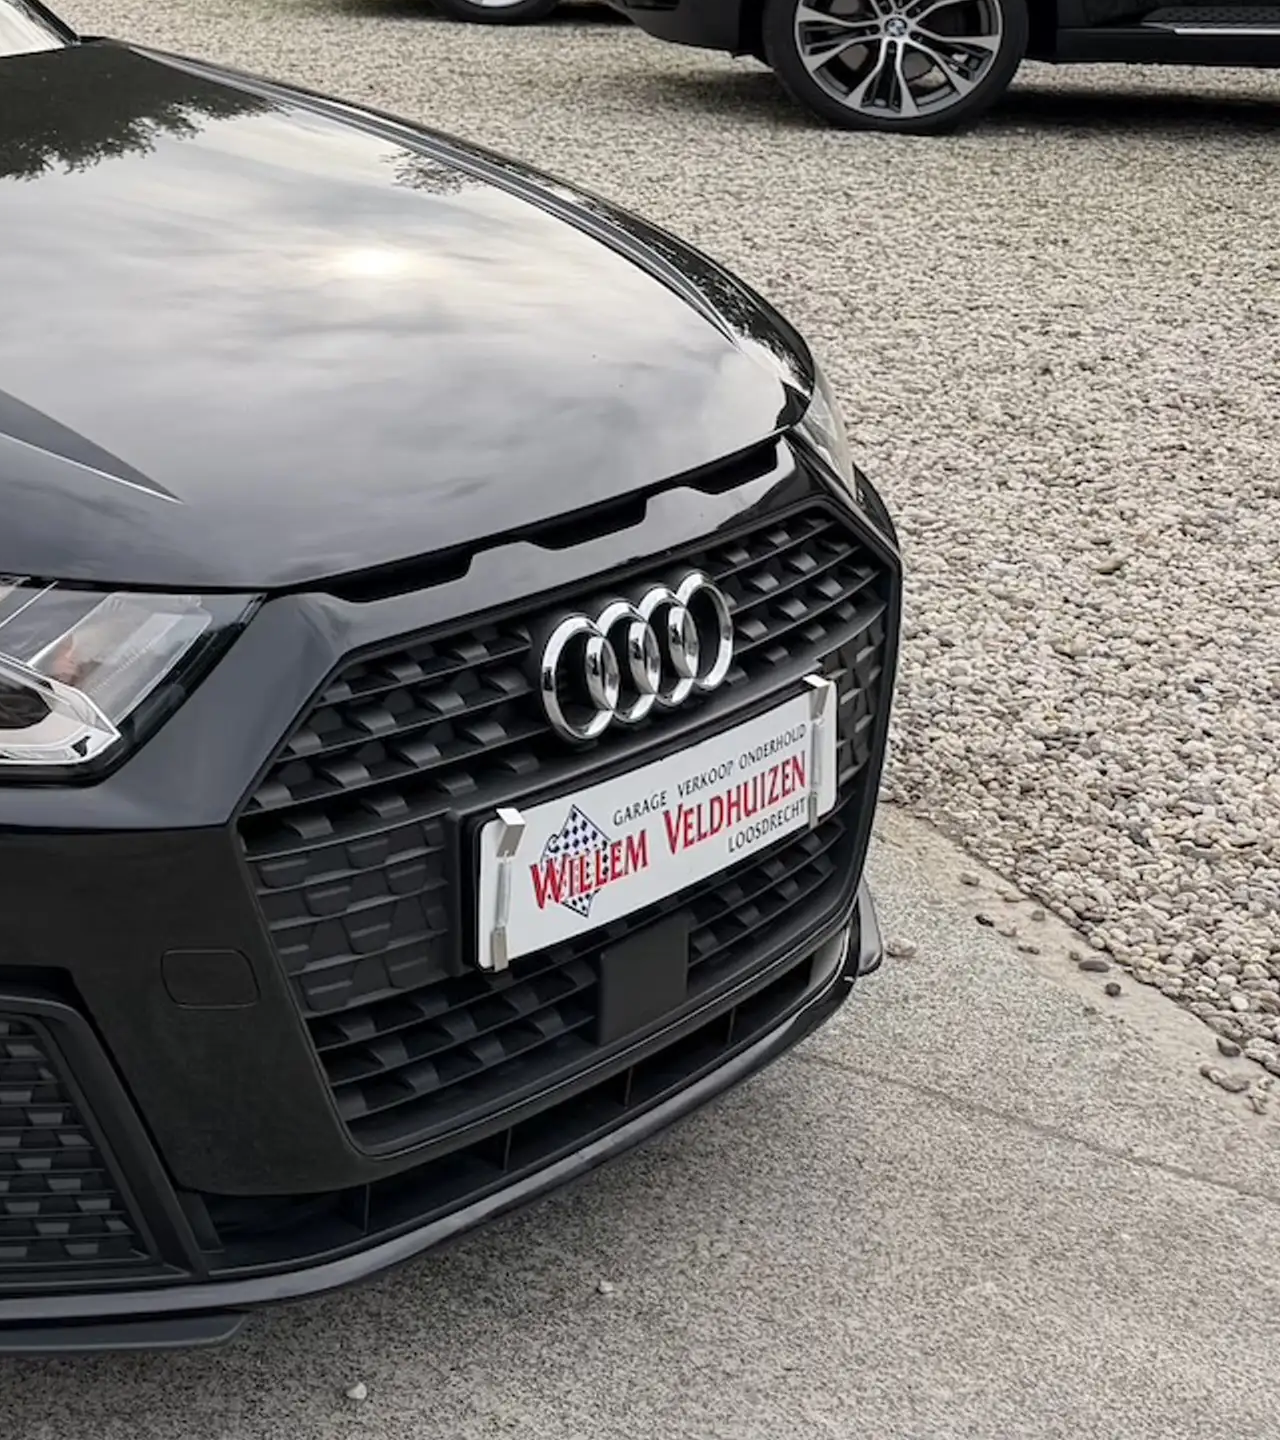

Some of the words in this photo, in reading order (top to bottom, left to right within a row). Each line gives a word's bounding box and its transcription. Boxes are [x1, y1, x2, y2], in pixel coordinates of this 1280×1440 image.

[612, 789, 668, 827] GARAGE
[677, 759, 734, 799] VERKOOP
[739, 723, 807, 770] ONDERHOUD
[727, 796, 806, 853] LOOSDRECHT
[529, 828, 648, 910] WILLEM
[662, 750, 806, 855] VELDHUIZEN
